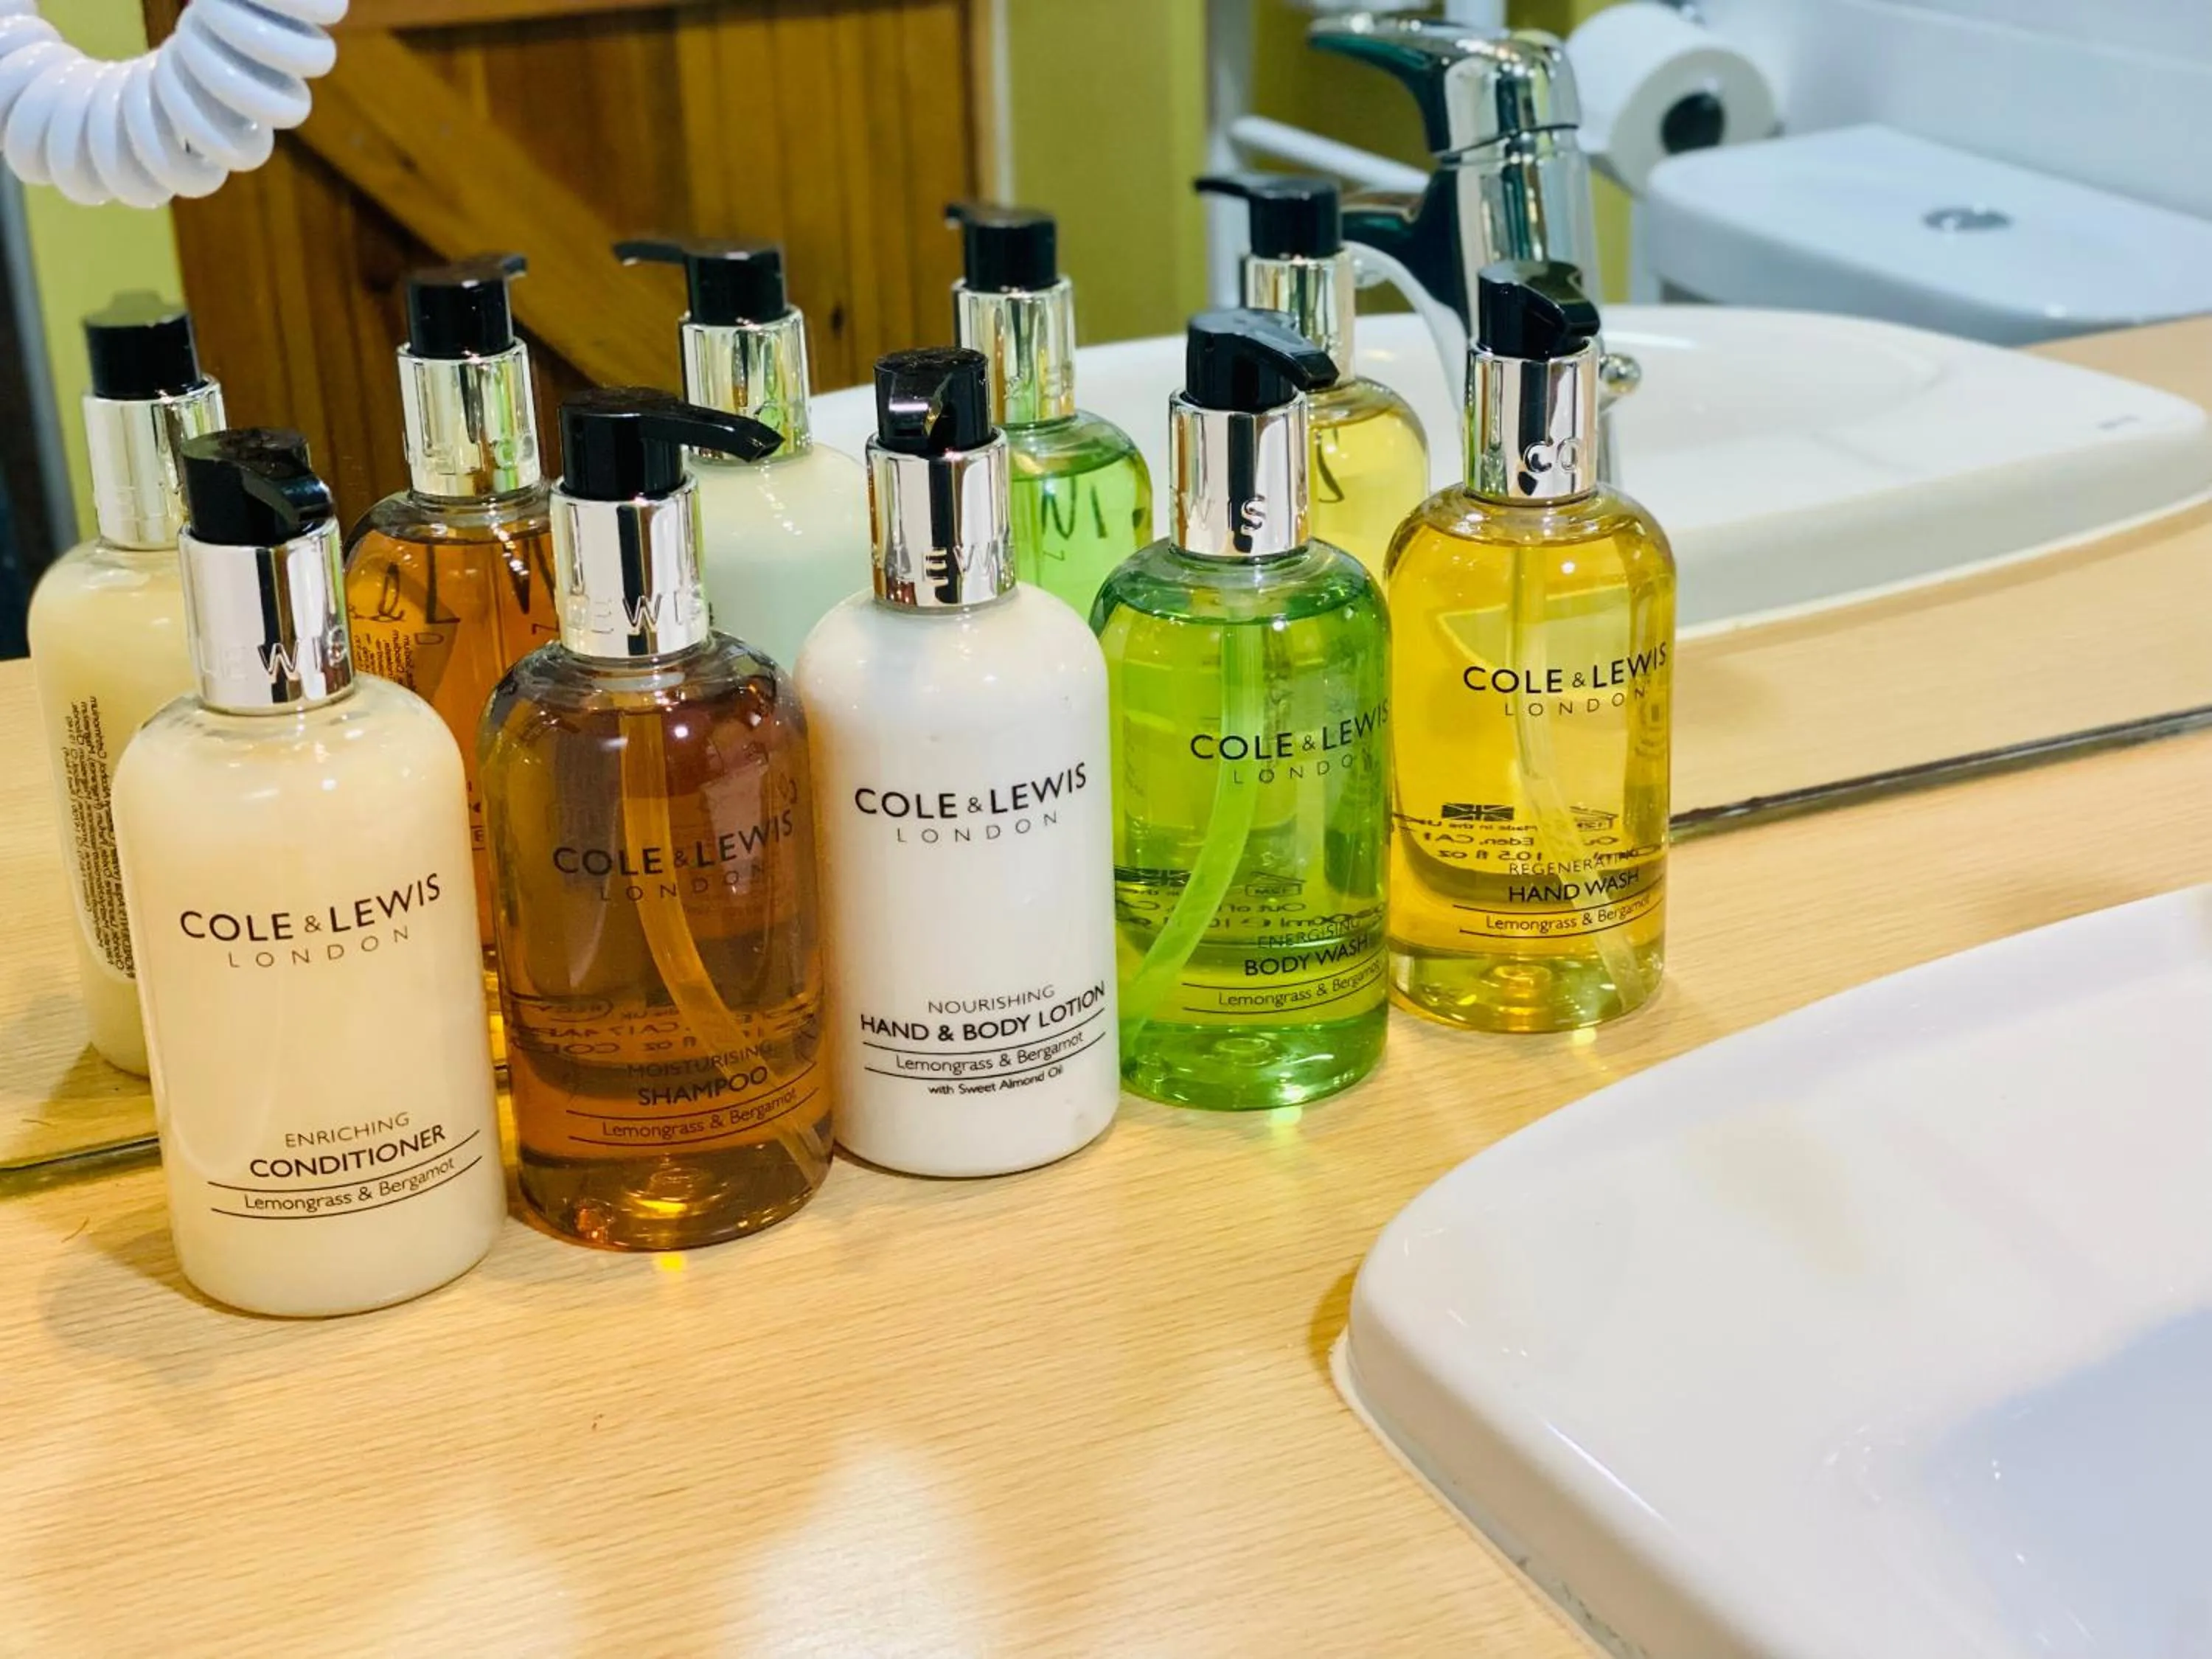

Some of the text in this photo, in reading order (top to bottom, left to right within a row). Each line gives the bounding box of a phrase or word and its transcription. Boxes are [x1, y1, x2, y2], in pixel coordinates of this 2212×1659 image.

[1464, 641, 1667, 694] COLE & LEWIS
[1505, 687, 1645, 717] LONDON
[1191, 698, 1389, 760] COLE & LEWIS
[1233, 748, 1373, 785] LONDON
[855, 762, 1087, 819] COLE & LEWIS
[554, 810, 793, 876] COLE & LEWIS
[897, 811, 1057, 843] LONDON
[600, 863, 766, 902] LONDON
[1509, 867, 1640, 903] HAND WASH
[180, 873, 441, 942] COLE & LEWIS
[1486, 894, 1651, 934] Lemongrass & Bergamot
[228, 925, 409, 967] LONDON
[1257, 918, 1360, 949] ENERGISING
[1245, 934, 1369, 976] BODY WASH
[860, 981, 1105, 1042] HAND & BODY LOTION
[928, 984, 1056, 1015] NOURISHING
[1218, 989, 1312, 1007] Lemongrass
[1316, 983, 1327, 997] &
[626, 1042, 774, 1079] MOISTURISING
[896, 1032, 1085, 1076] Lemongrass & Bergamot
[638, 1065, 768, 1106] SHAMPOO
[928, 1064, 1063, 1095] with Sweet Almond Oil
[285, 1112, 410, 1148] ENRICHING
[602, 1088, 797, 1141] Lemongrass & Bergamot
[250, 1124, 446, 1178] CONDITIONER
[244, 1158, 455, 1214] Lemongrass & Bergamot
